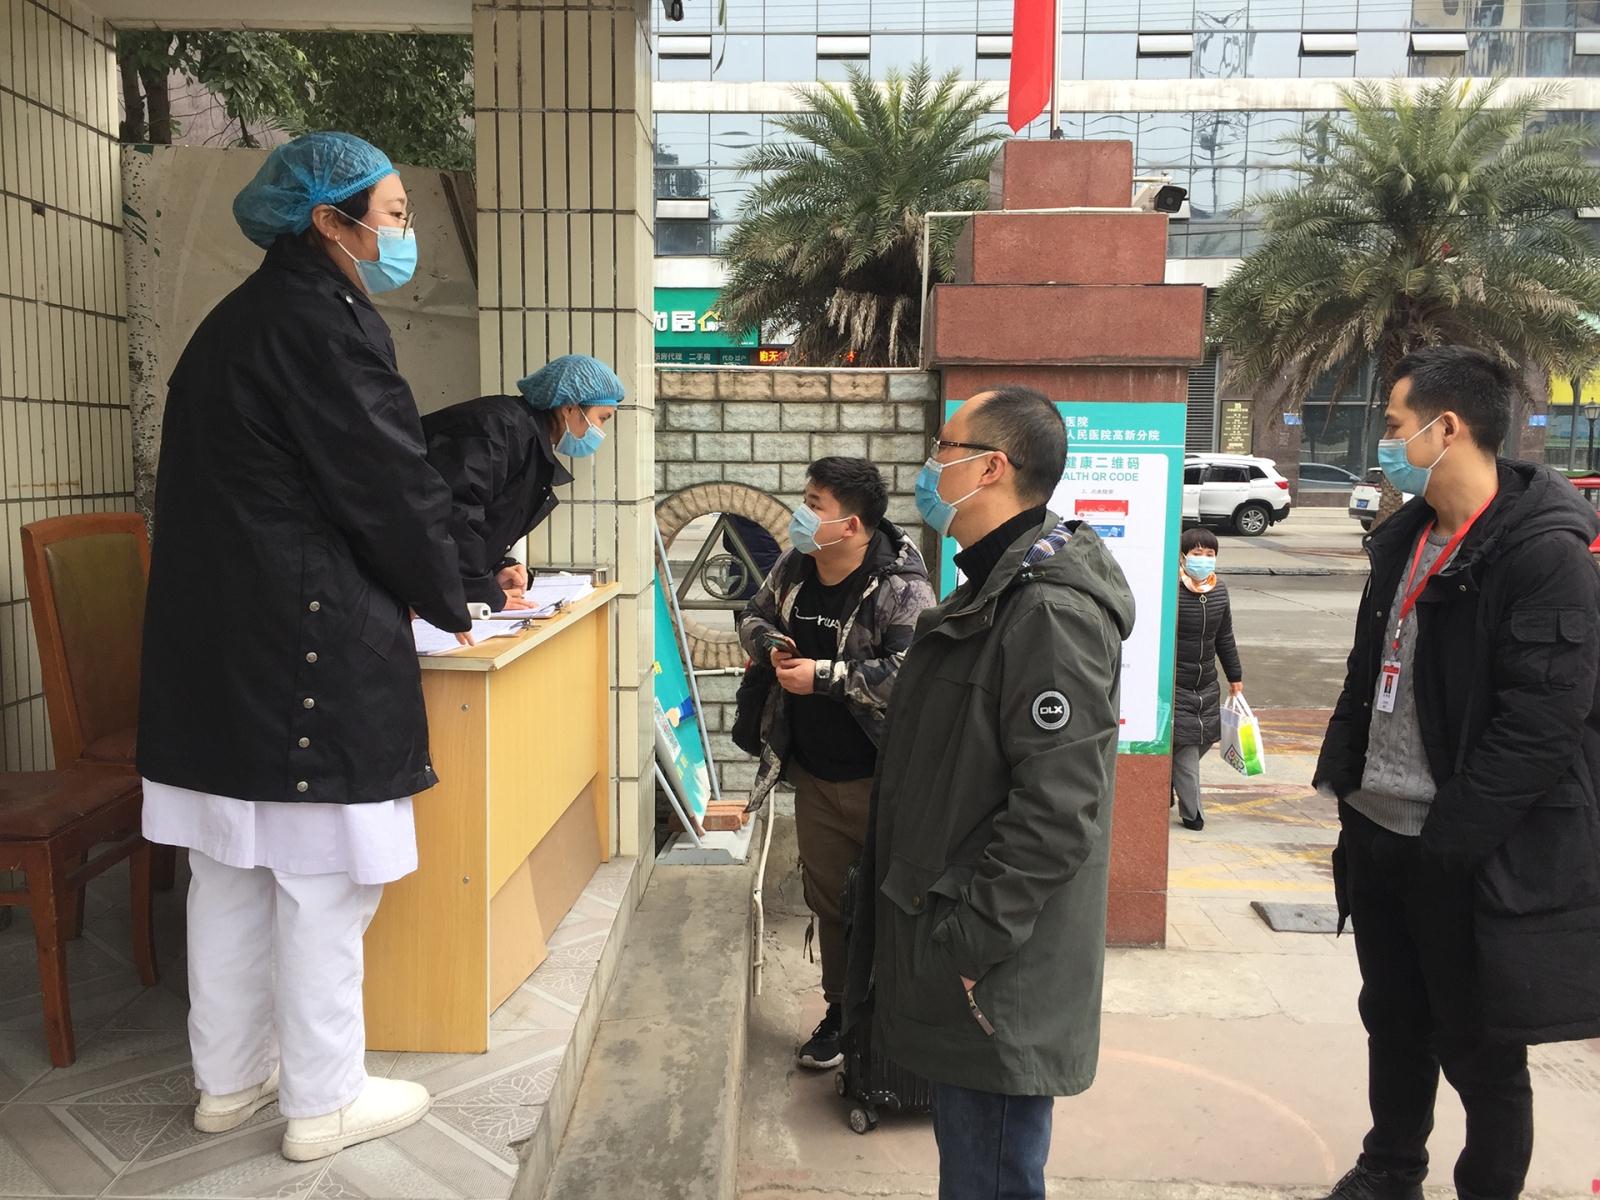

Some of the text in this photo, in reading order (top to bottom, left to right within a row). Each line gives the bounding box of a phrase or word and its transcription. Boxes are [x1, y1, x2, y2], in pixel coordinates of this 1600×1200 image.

[1065, 416, 1089, 428] 医院
[1066, 429, 1160, 441] 人民医院高新分院
[1091, 472, 1107, 481] QR
[1109, 472, 1139, 482] CODE
[1040, 705, 1063, 715] DLX
